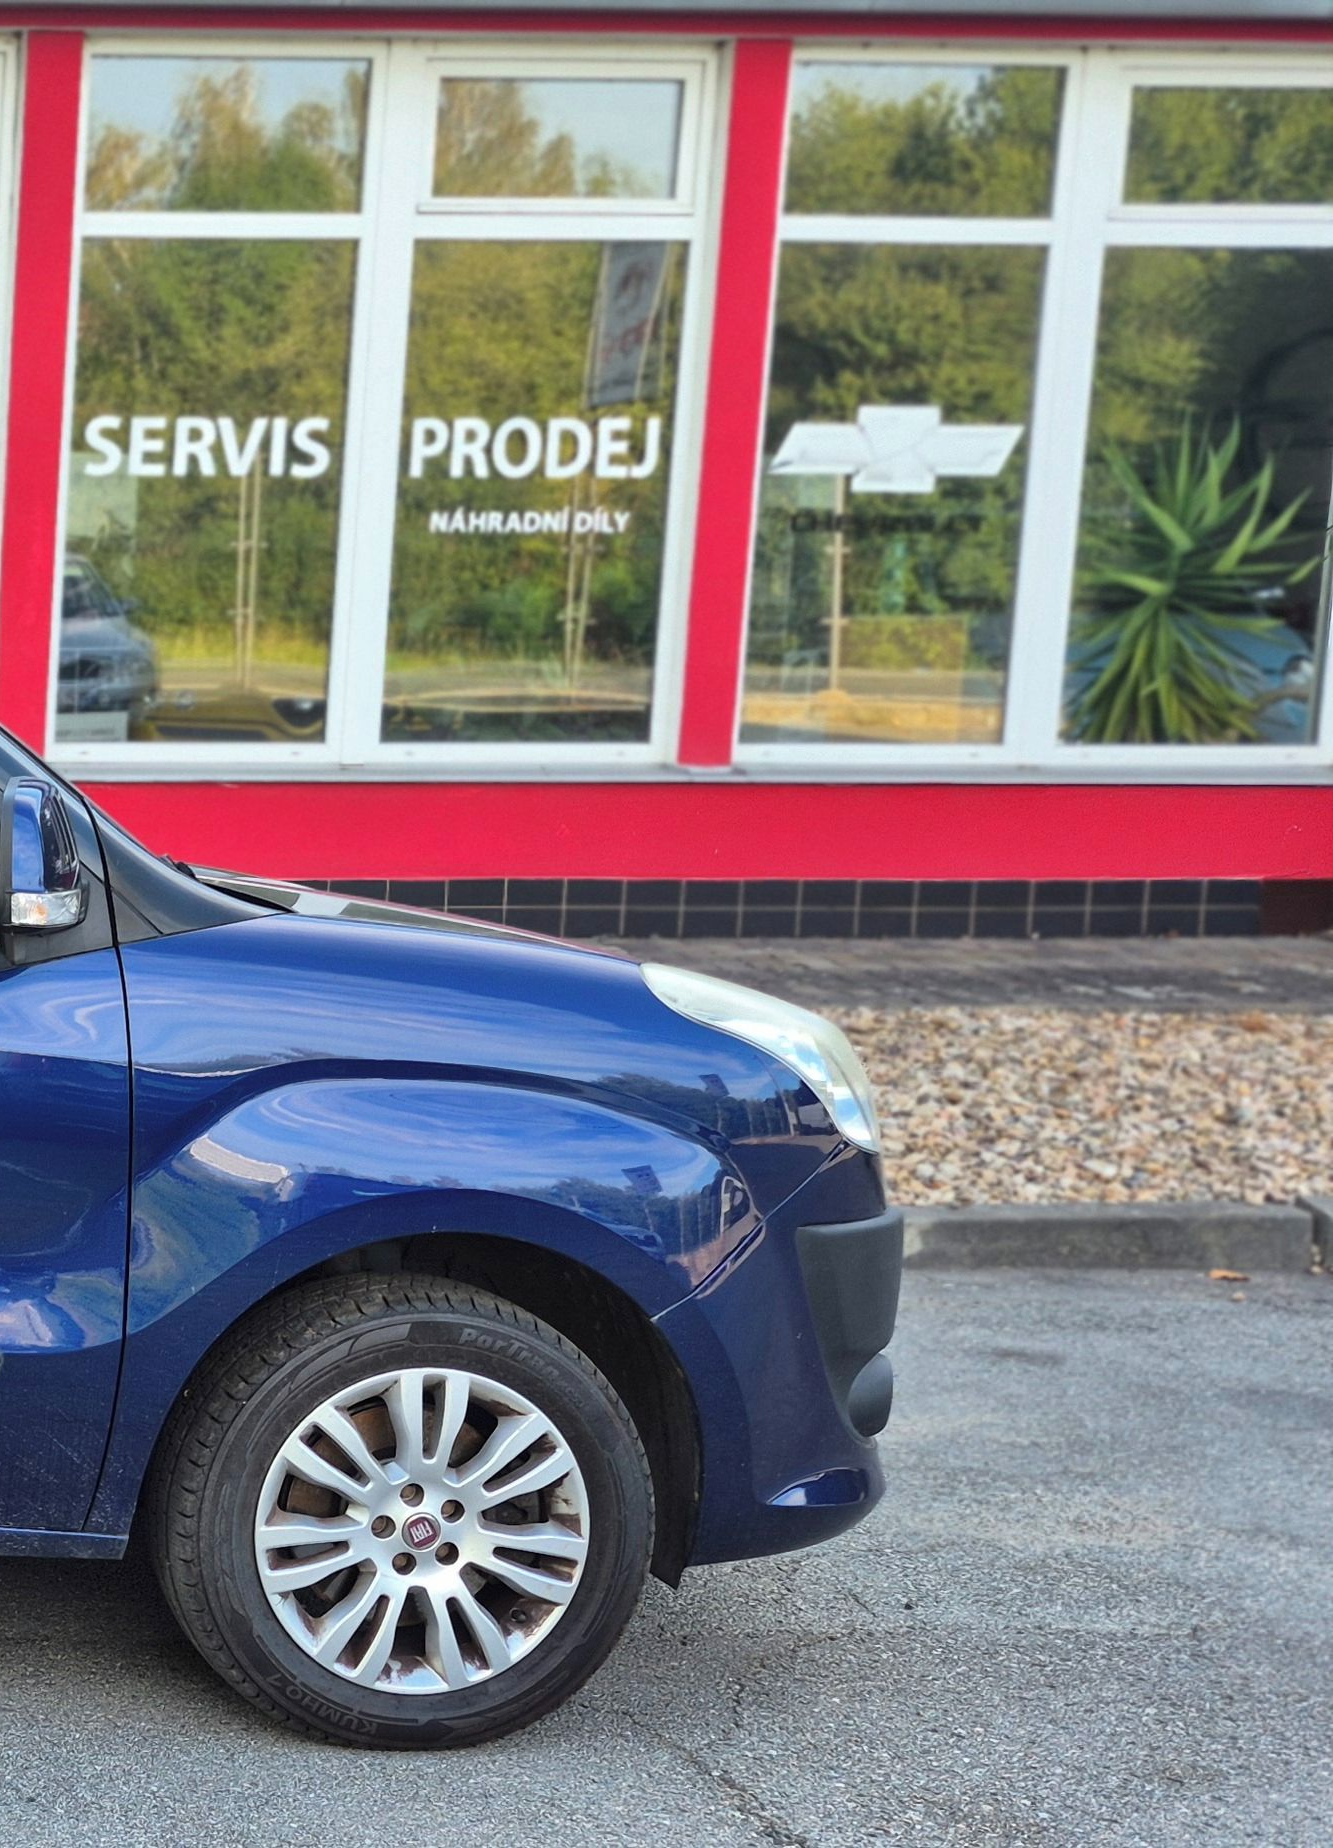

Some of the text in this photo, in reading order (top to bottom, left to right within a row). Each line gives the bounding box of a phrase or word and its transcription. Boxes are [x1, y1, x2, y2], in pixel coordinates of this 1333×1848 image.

[83, 415, 332, 478] SERVIS
[409, 415, 662, 479] PRODEJ
[429, 505, 631, 534] NÁHRADNÍ DÍLY
[409, 1520, 433, 1543] FIAT
[285, 1685, 378, 1735] KUMHO
